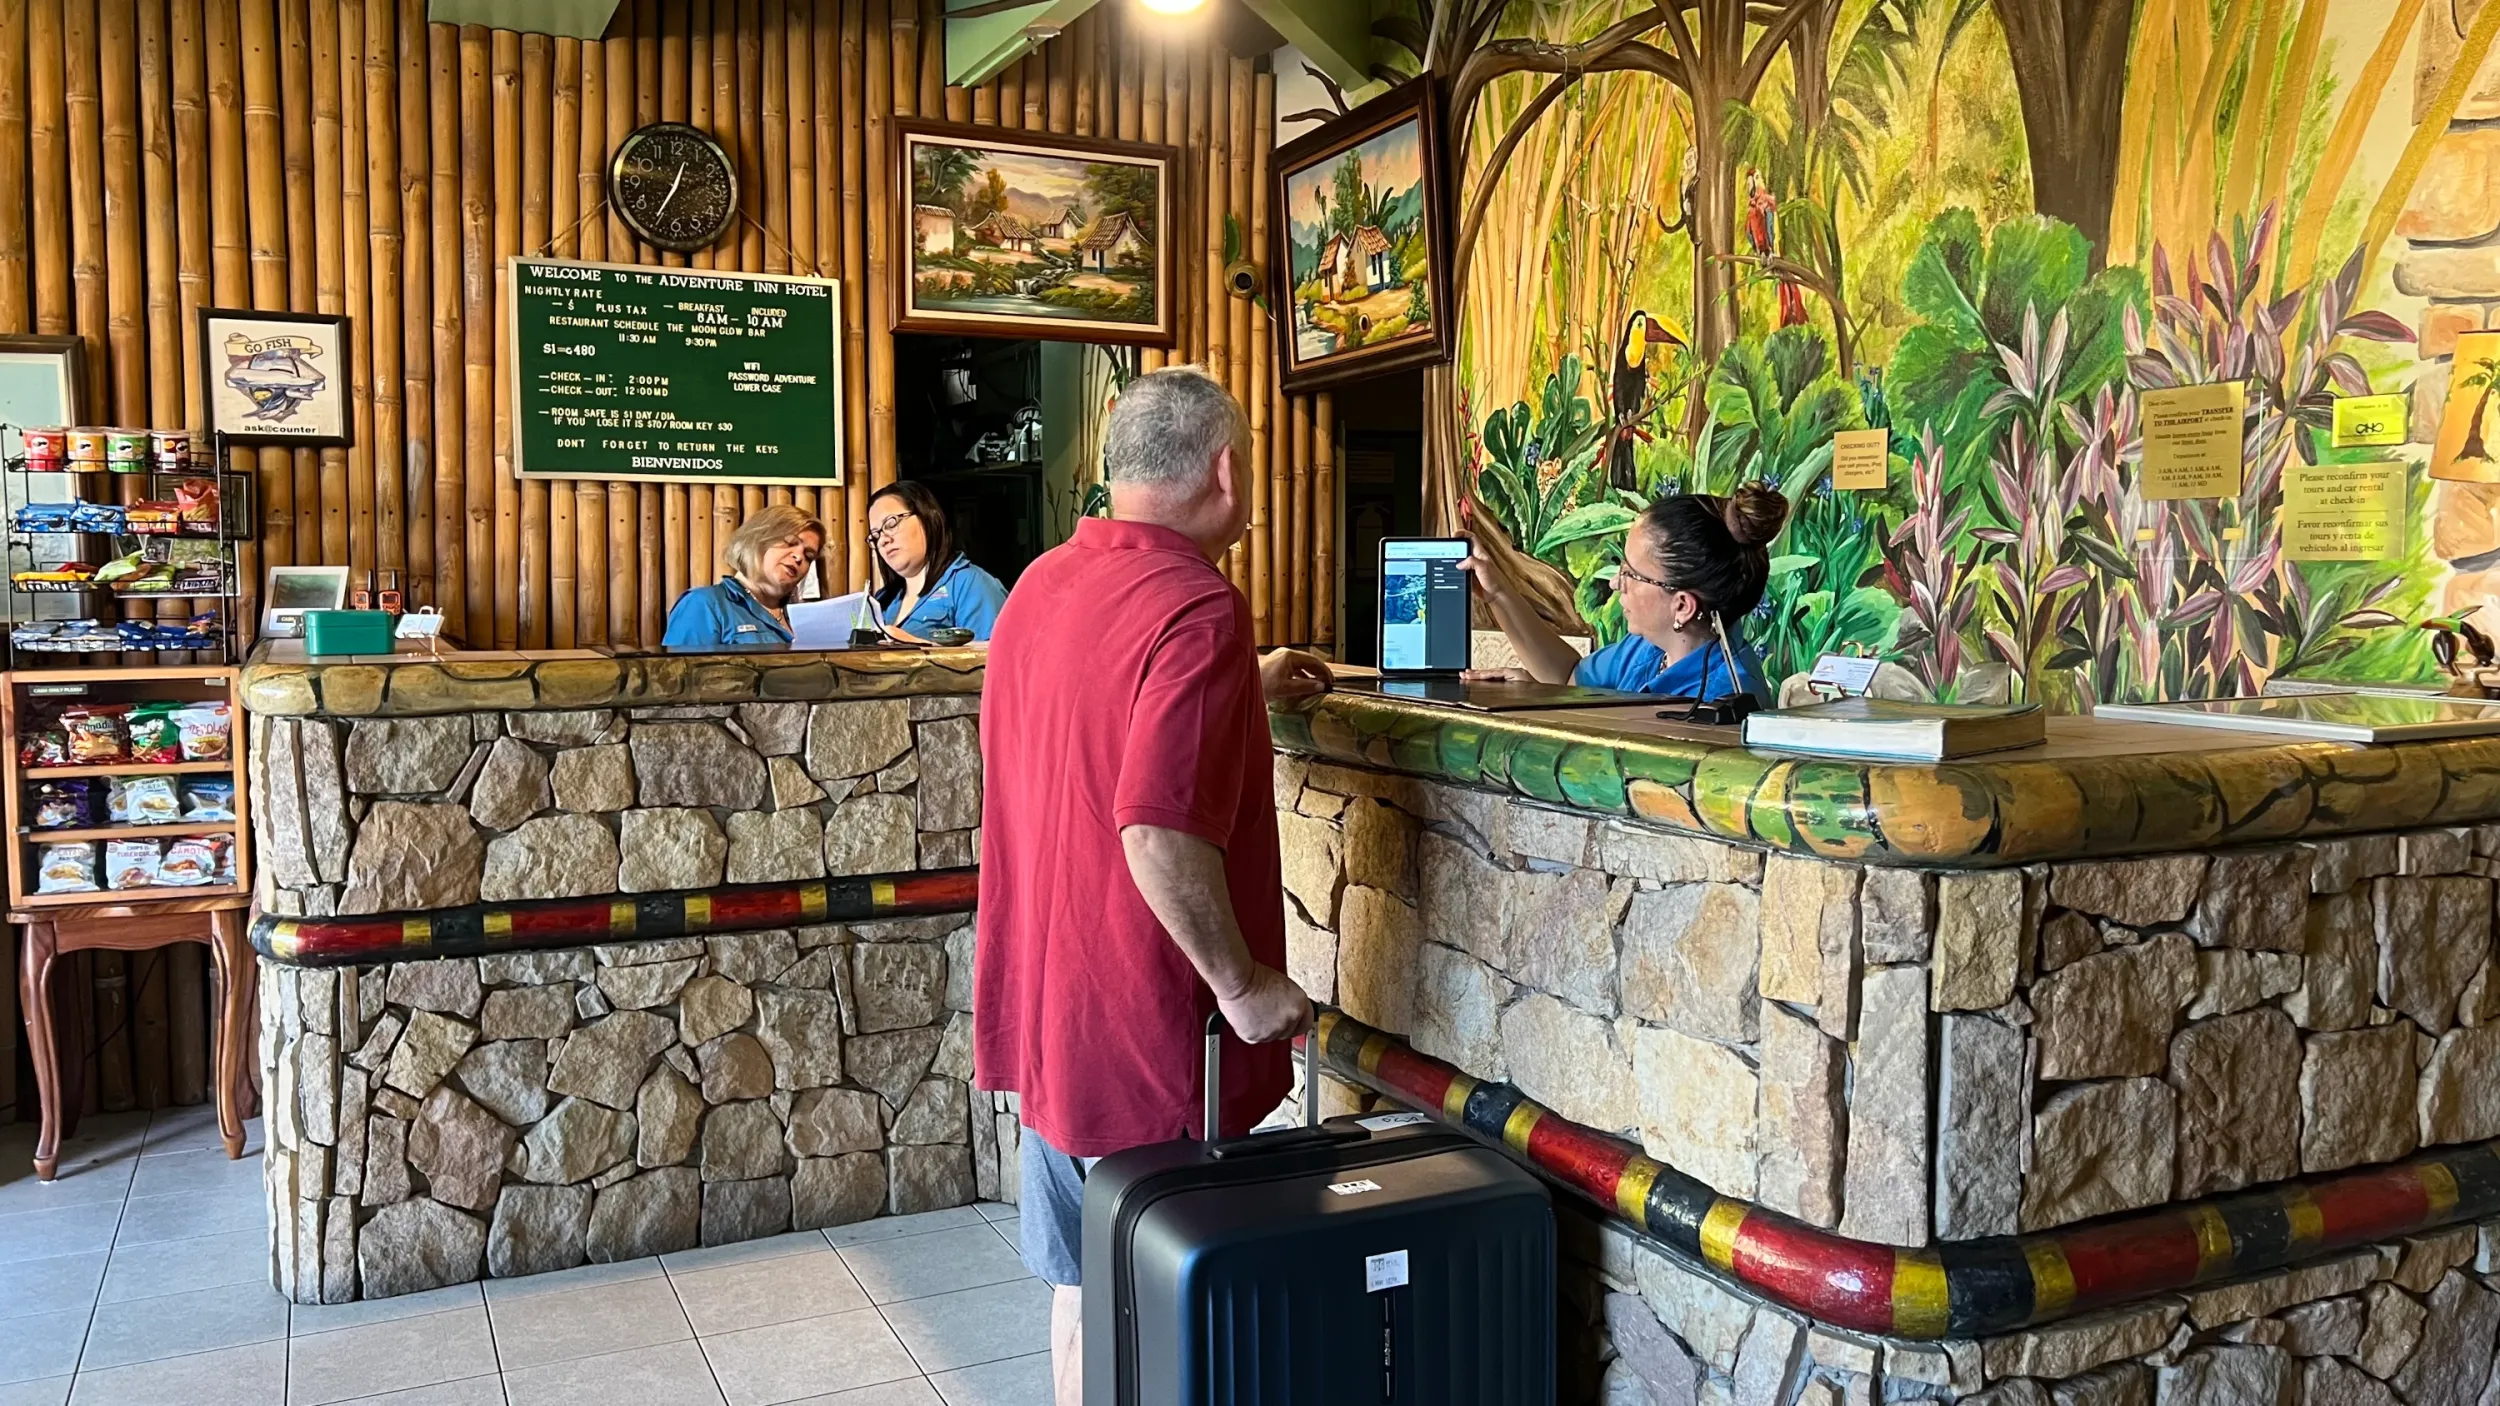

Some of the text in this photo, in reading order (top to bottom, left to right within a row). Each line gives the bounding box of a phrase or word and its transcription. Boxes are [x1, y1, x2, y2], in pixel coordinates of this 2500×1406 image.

[529, 265, 828, 297] WELCOME TO THE ADVENTURE INN HOTEL
[524, 285, 603, 299] NIGHTLY RATE
[596, 303, 622, 313] PLUS
[626, 305, 647, 315] TAX
[678, 302, 788, 318] BREAKFAST INCLUDED
[549, 316, 766, 338] RESTAURANT SCHEDULE THE MOON GLOW BAR
[244, 338, 292, 354] GO FISH
[743, 362, 760, 371] WIFI
[728, 371, 817, 385] PASSWORD ADVENTURE
[733, 383, 782, 393] LOWER CASE
[551, 407, 578, 417] ROOM
[583, 408, 606, 418] SAFE
[610, 409, 619, 418] IS
[635, 411, 652, 420] DAY
[2201, 407, 2234, 416] TRANSFER
[554, 416, 562, 426] IF
[567, 417, 586, 426] YOU
[596, 418, 619, 428] LOSE
[622, 418, 631, 428] IT
[635, 419, 643, 428] IS
[696, 422, 713, 431] KEY
[718, 423, 733, 432] $30
[2177, 417, 2204, 426] AIRPORT
[244, 424, 317, 434] ask@counter
[602, 439, 648, 450] FORGET
[657, 441, 670, 451] TO
[676, 442, 715, 452] RETURN
[726, 443, 745, 453] THE
[755, 445, 779, 454] KEYS
[631, 456, 723, 470] BIENVENIDOS
[2299, 470, 2390, 483] Please reconfirm your
[2303, 482, 2384, 494] tours and car rental
[2320, 495, 2366, 505] at check-in
[2297, 518, 2389, 529] Favor reconfirmar sus
[2310, 531, 2331, 541] tours
[2340, 531, 2361, 541] renta
[2364, 531, 2374, 540] de
[2339, 543, 2348, 552] al
[2350, 543, 2384, 554] ingresar
